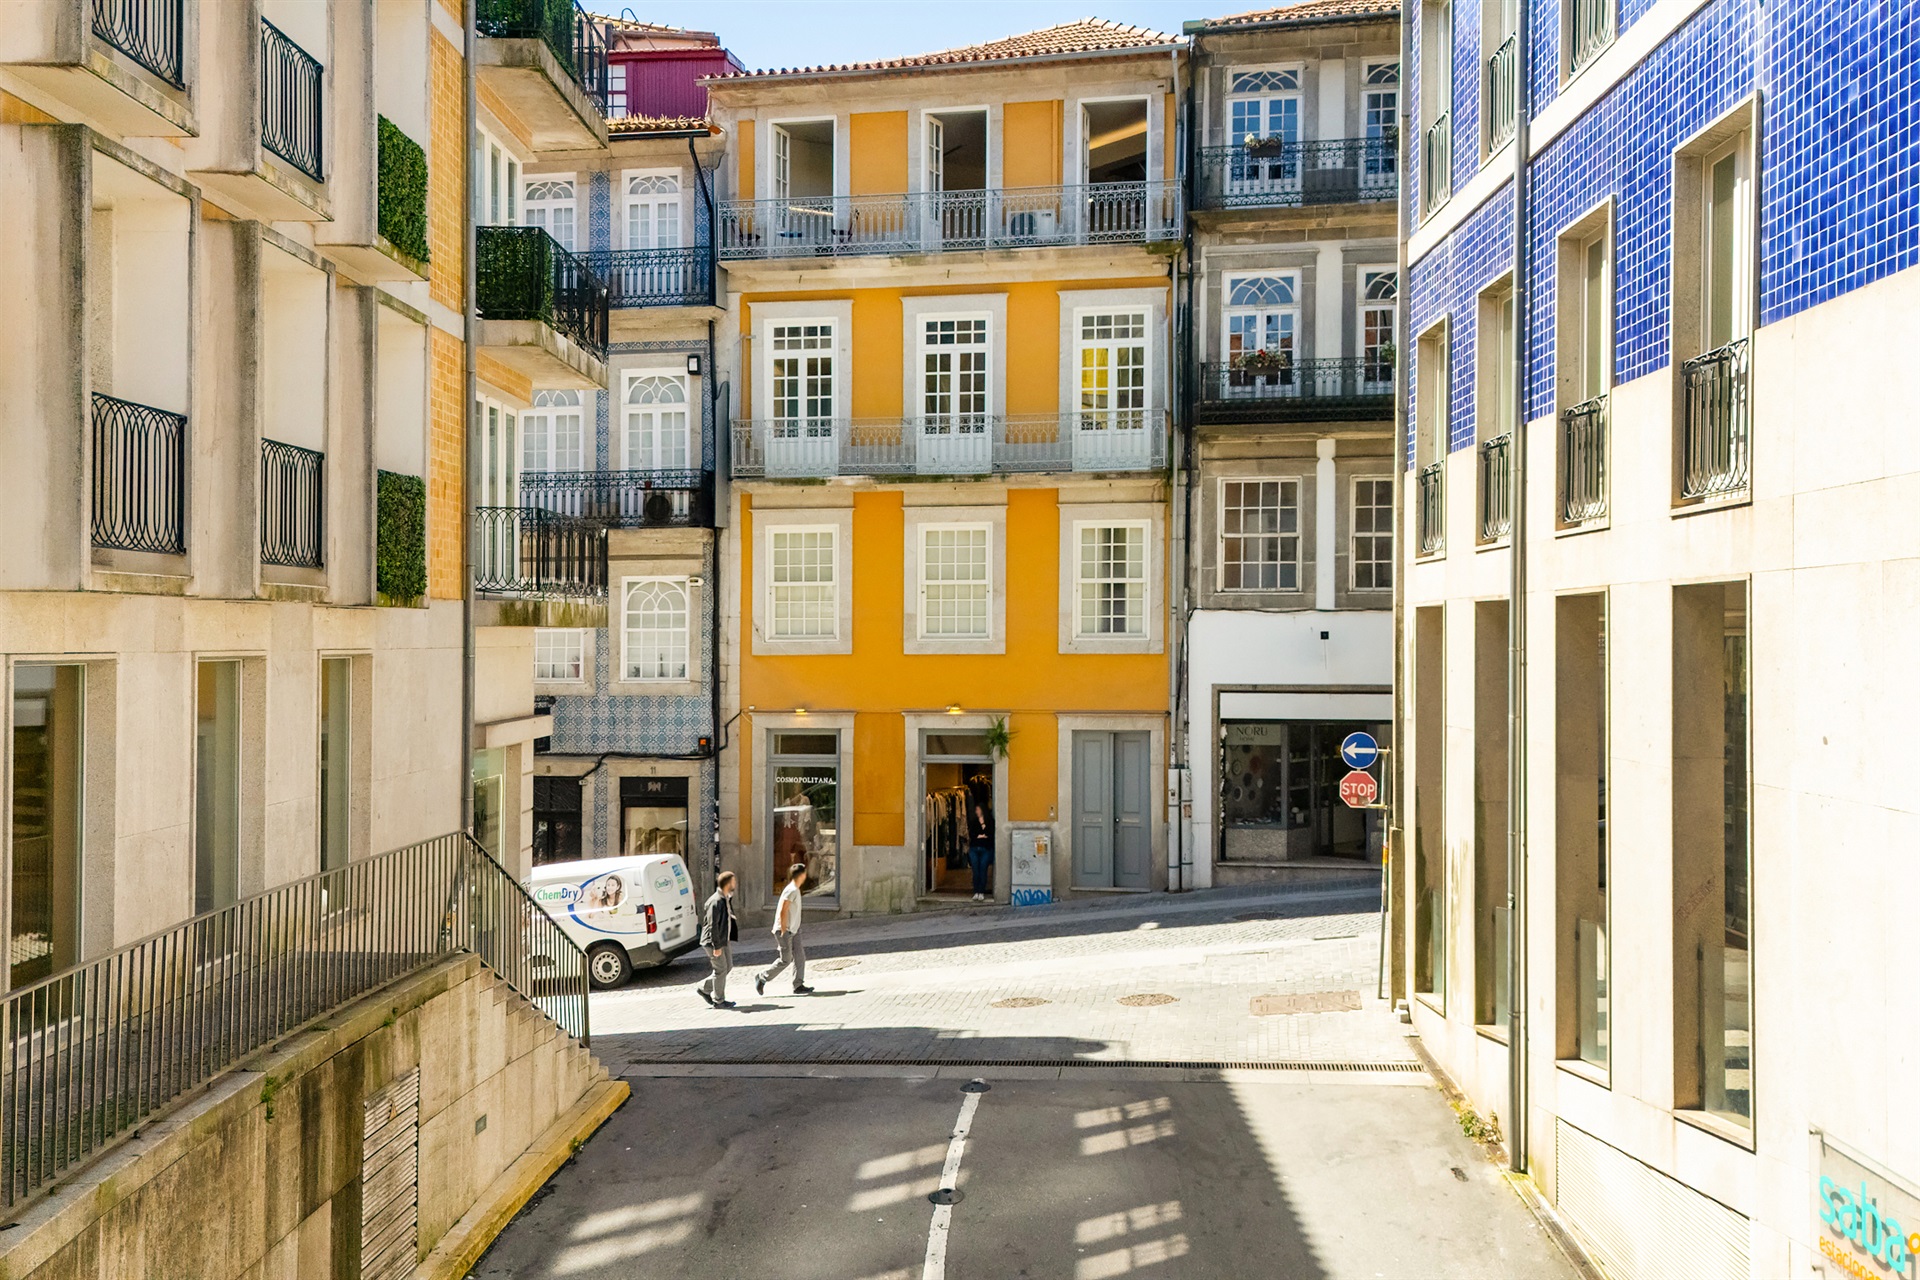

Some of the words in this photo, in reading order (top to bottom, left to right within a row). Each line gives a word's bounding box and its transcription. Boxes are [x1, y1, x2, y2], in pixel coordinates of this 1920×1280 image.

[1236, 726, 1268, 736] NORU
[1342, 782, 1375, 796] STOP
[537, 887, 578, 901] ChemDry
[1819, 1174, 1906, 1272] saba
